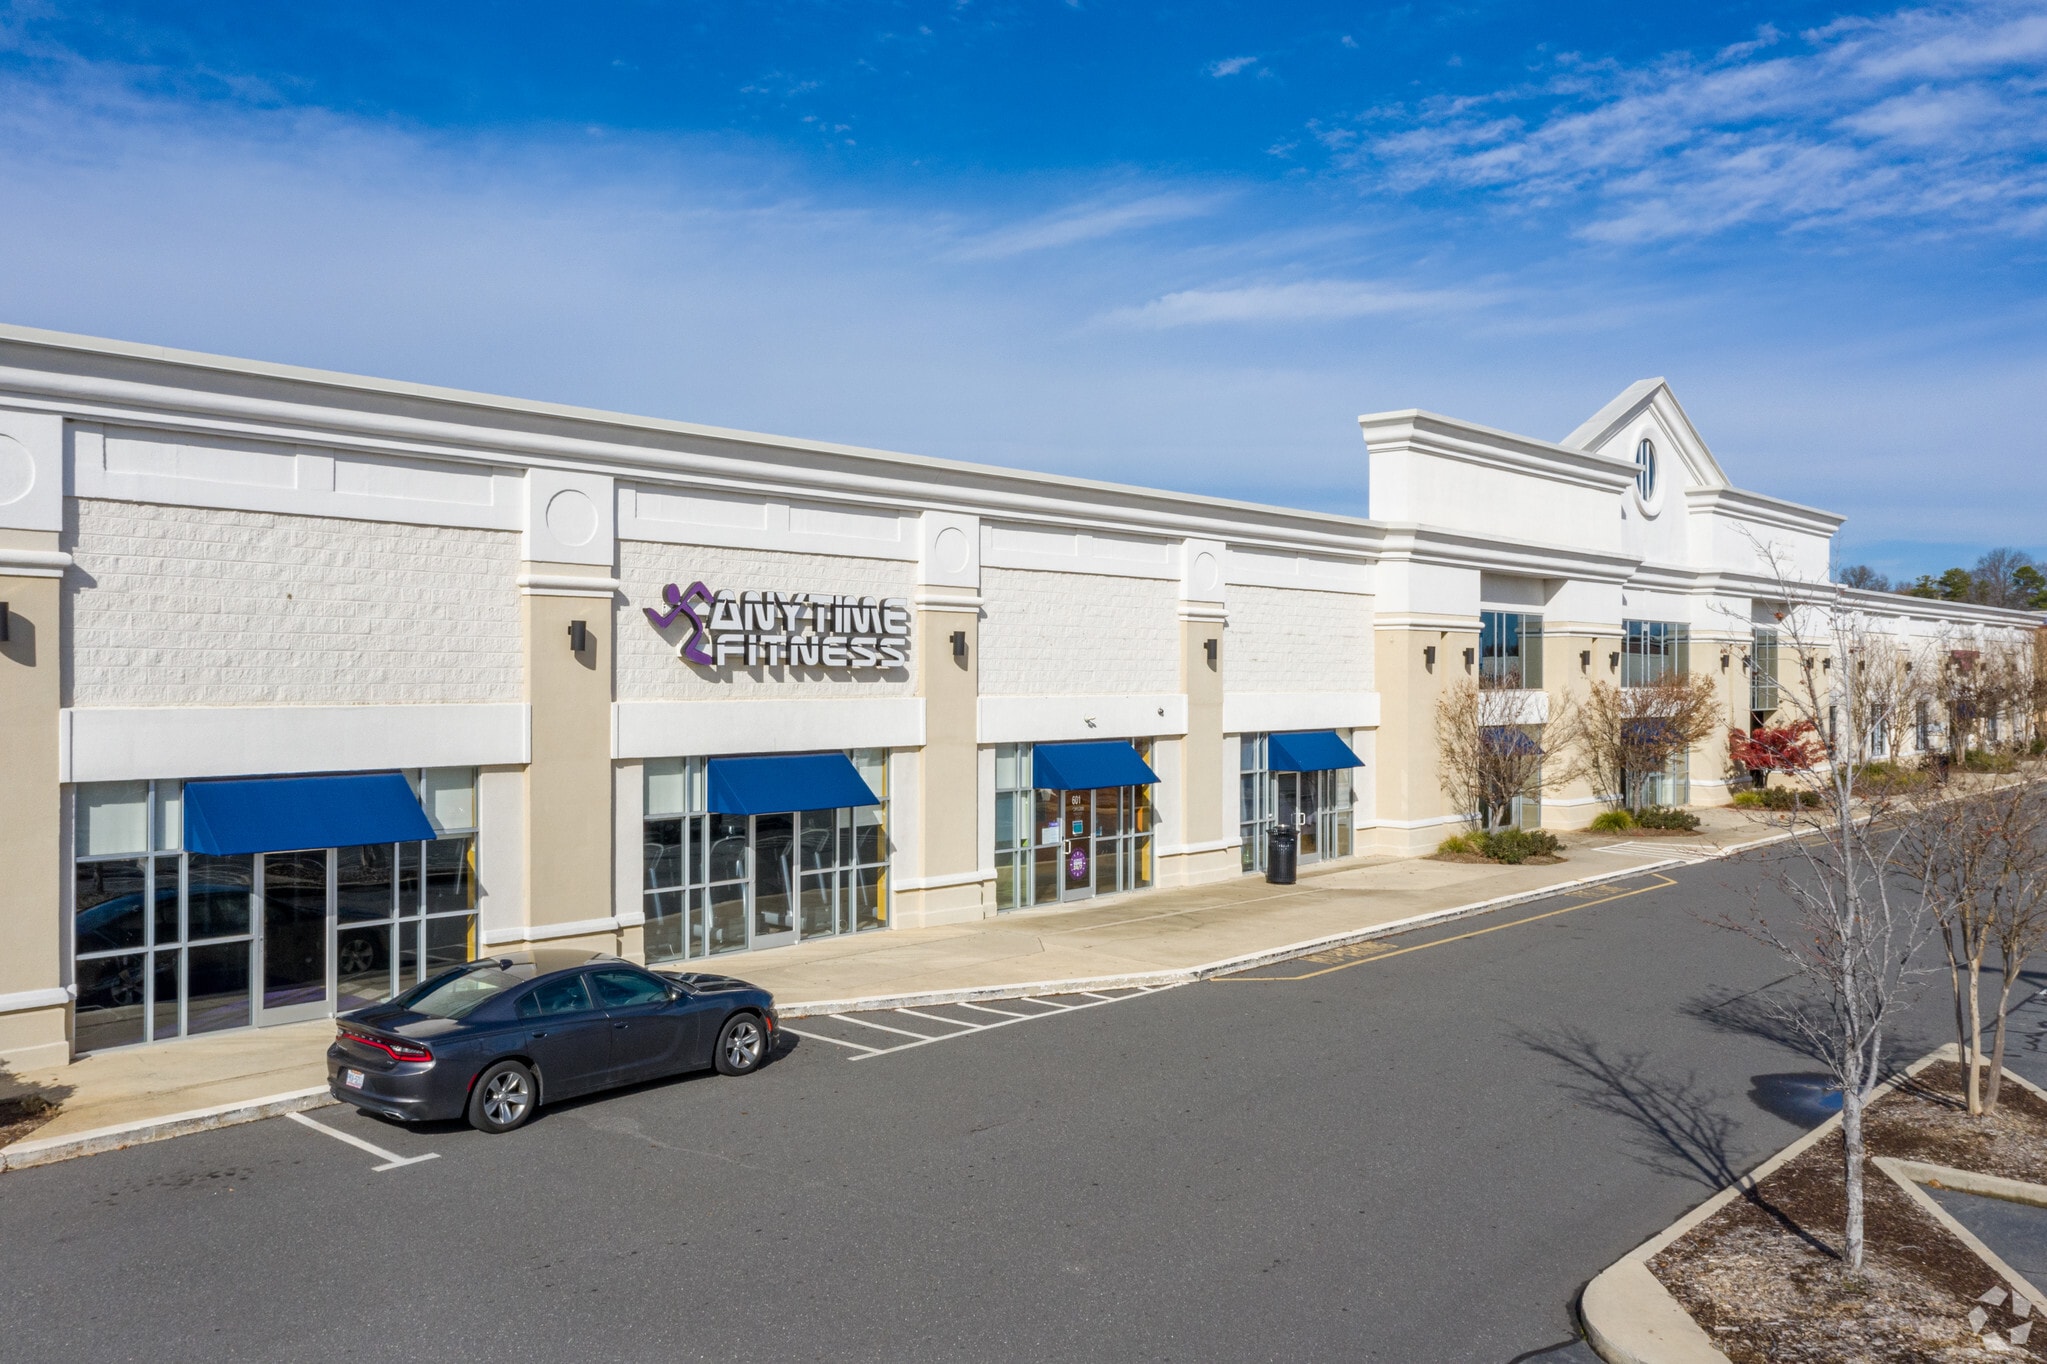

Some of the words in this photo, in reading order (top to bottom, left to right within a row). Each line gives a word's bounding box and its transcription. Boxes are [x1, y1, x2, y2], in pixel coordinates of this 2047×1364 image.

[709, 588, 908, 635] ANYTIME
[715, 633, 907, 667] FITNESS
[1071, 795, 1081, 805] 601
